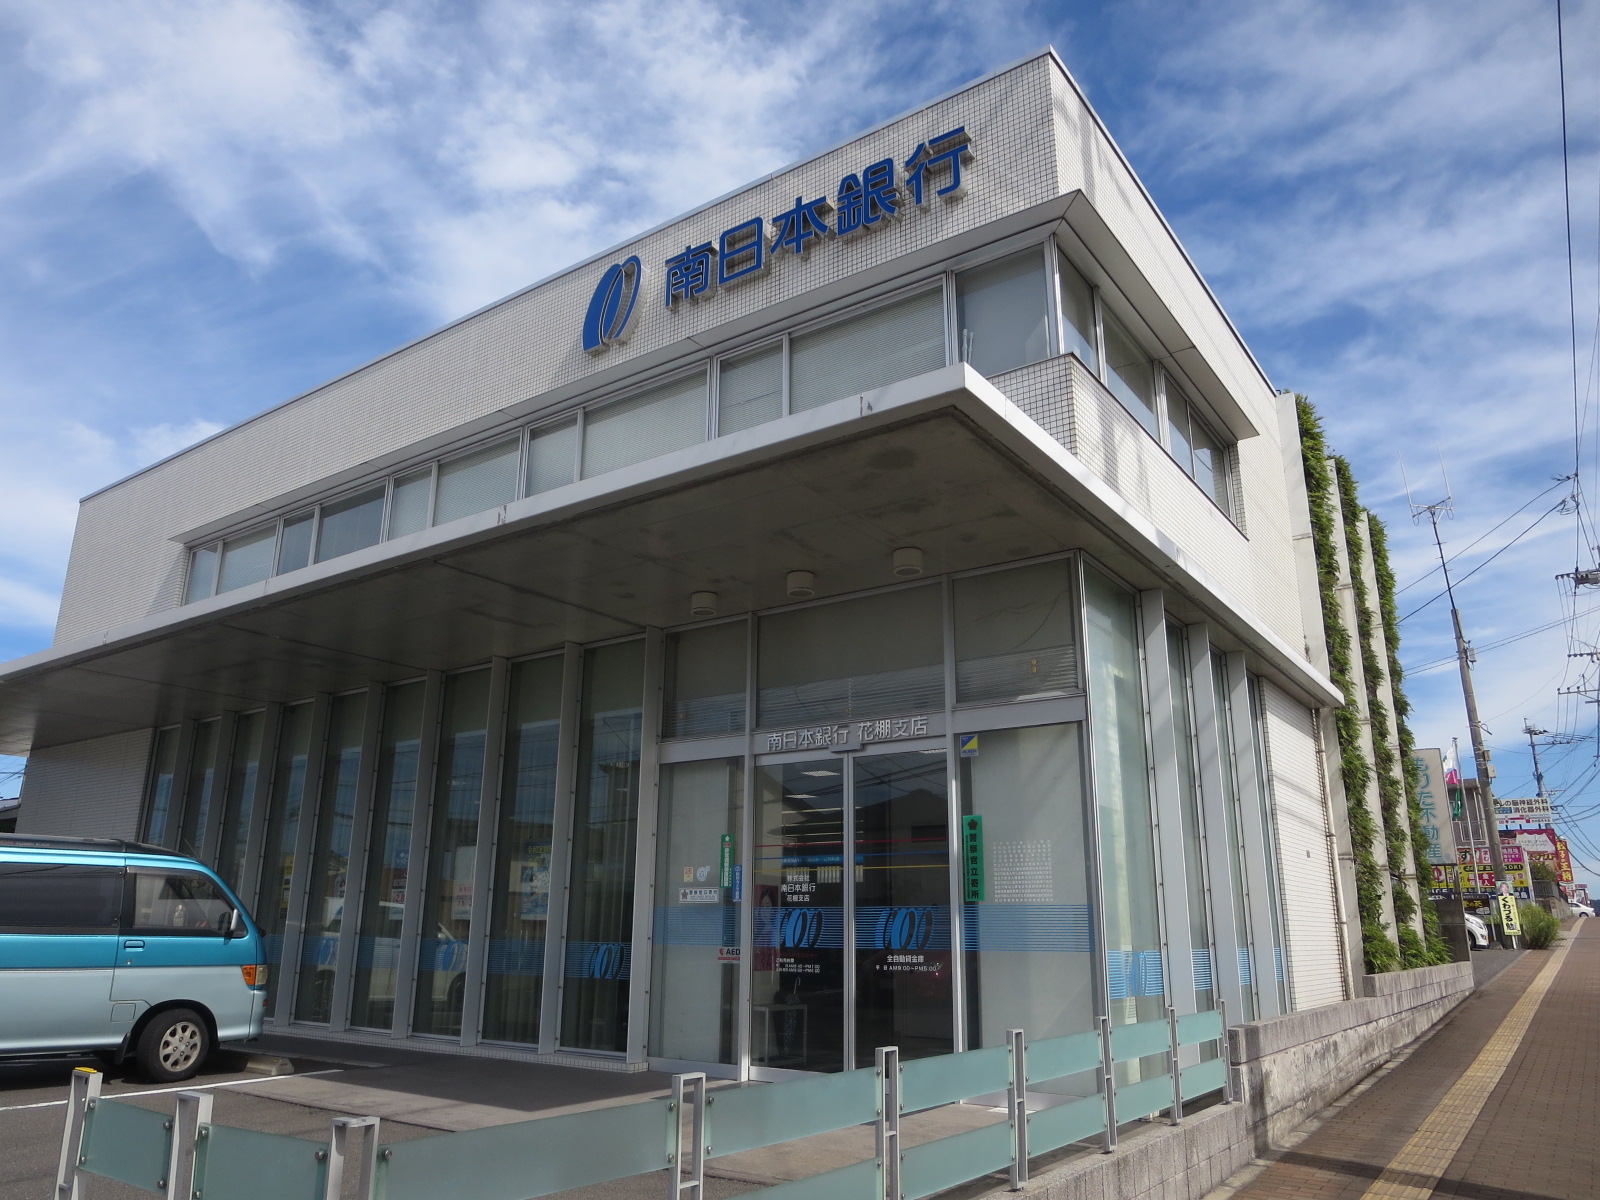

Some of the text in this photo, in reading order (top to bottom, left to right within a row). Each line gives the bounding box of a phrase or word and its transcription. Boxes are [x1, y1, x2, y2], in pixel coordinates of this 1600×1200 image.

[665, 125, 969, 308] 南日本銀行
[767, 716, 928, 752] 南日本銀行 花棚支店
[968, 833, 980, 899] 警察官立寄所
[781, 883, 816, 893] 南日本銀行
[786, 894, 810, 902] 花棚支店
[725, 948, 741, 956] AED
